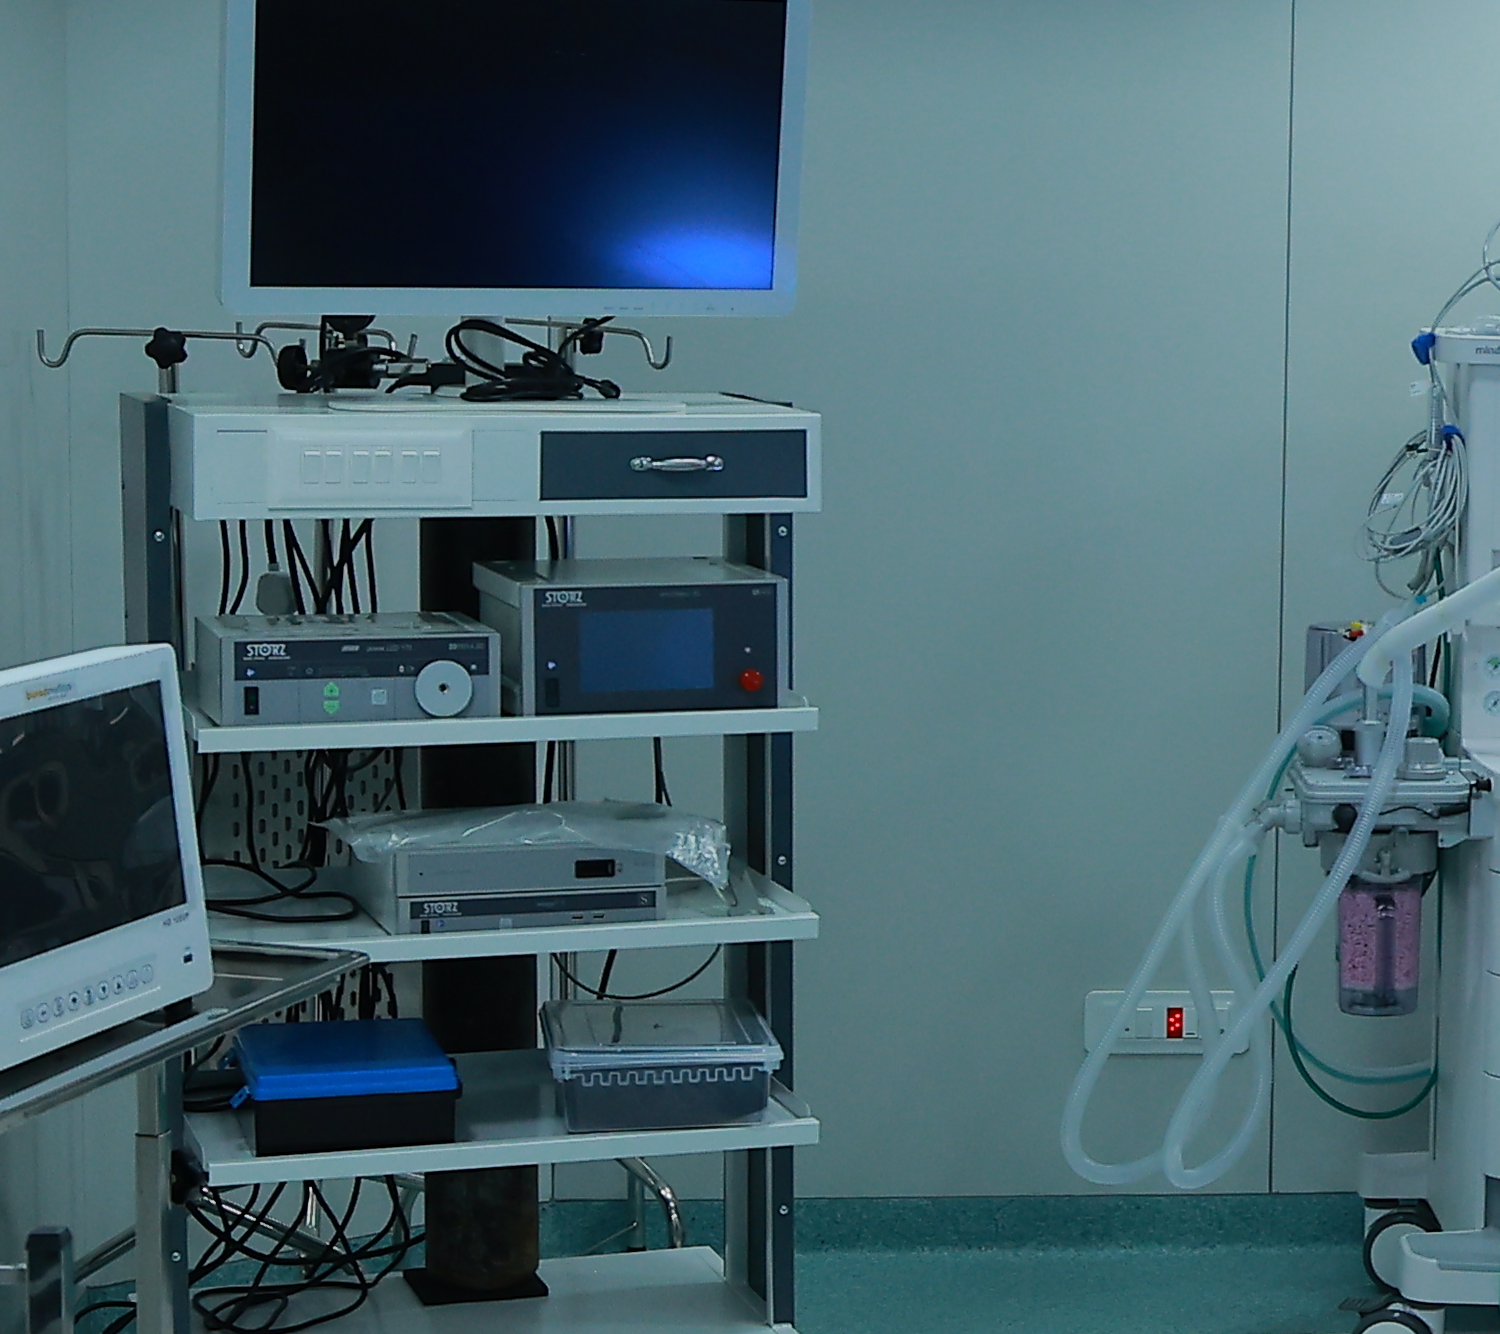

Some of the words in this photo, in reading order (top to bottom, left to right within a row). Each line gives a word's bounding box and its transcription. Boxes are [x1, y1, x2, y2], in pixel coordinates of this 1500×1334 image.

[545, 590, 584, 604] STORZ
[246, 643, 288, 657] STORZ
[422, 901, 460, 914] STORZ
